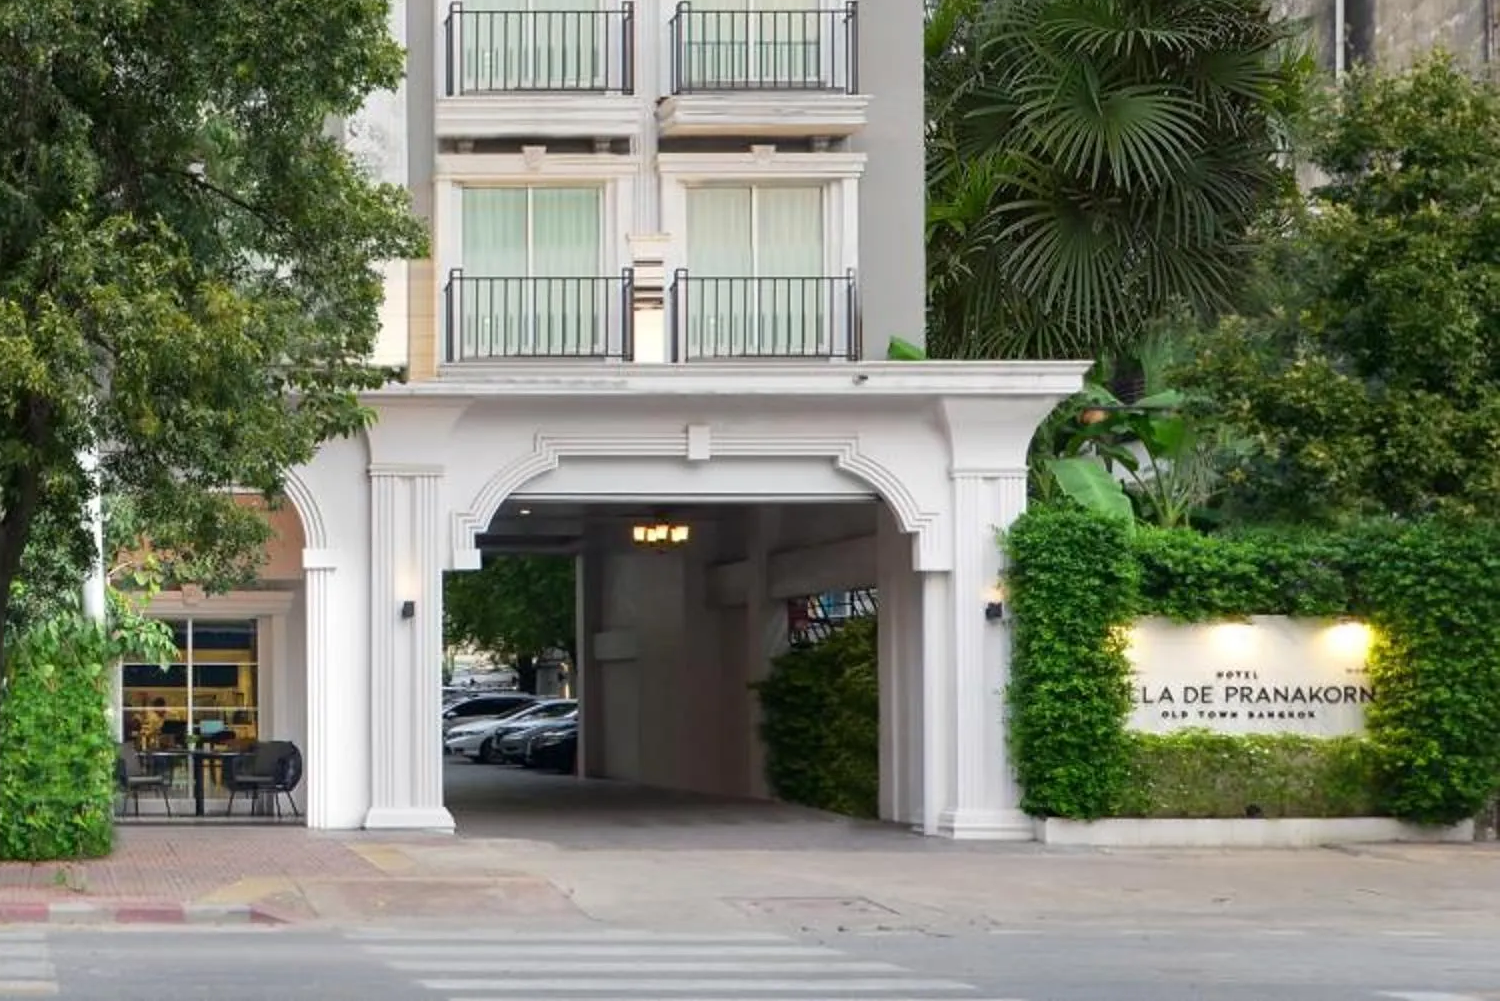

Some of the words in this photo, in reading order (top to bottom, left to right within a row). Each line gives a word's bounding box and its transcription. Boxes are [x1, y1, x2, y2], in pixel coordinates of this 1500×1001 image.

[1216, 670, 1258, 680] HOTEL
[1183, 686, 1214, 704] DE
[1225, 686, 1377, 704] PRANAKORN
[1161, 710, 1189, 720] OLD
[1198, 710, 1238, 720] TOWN
[1247, 710, 1316, 720] BANGKOK
